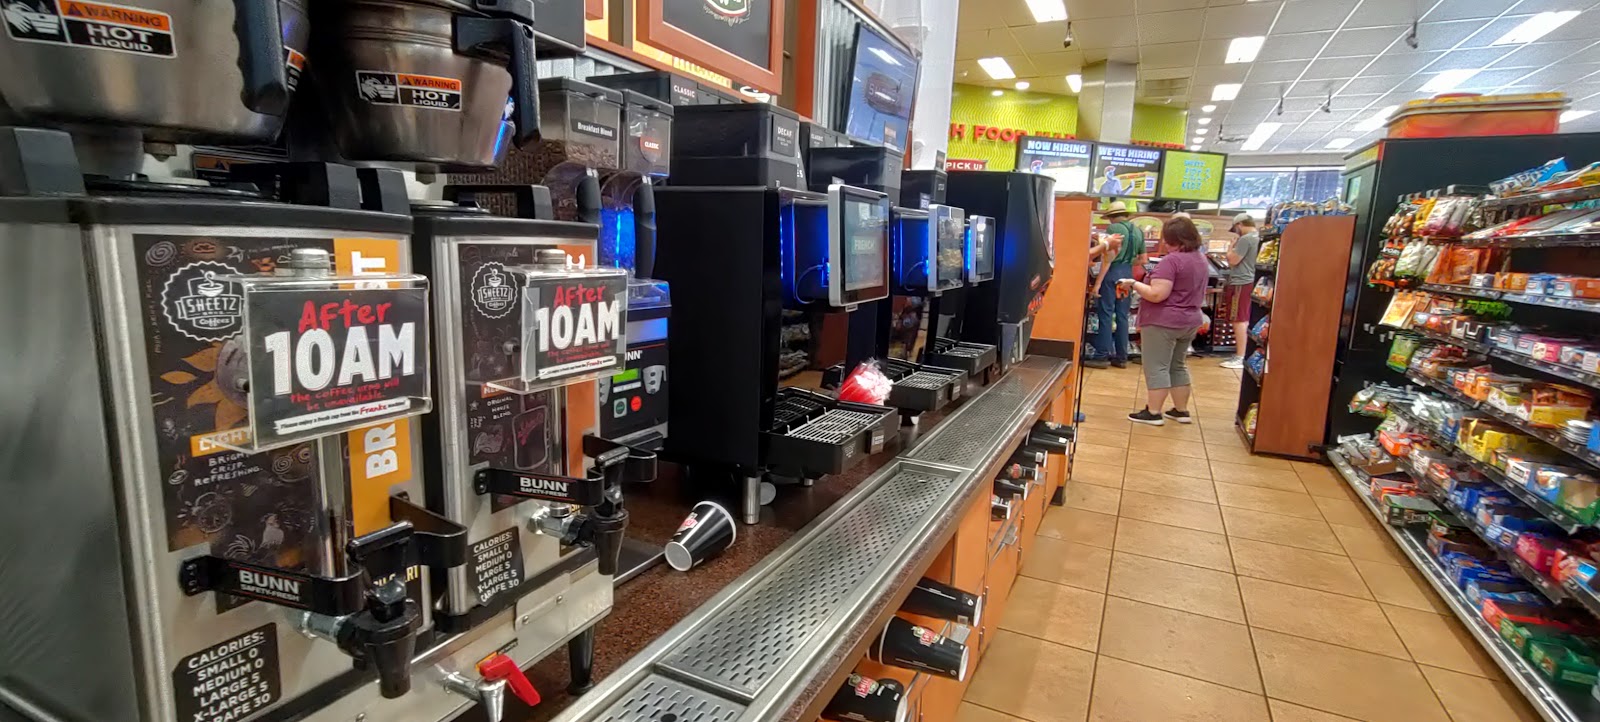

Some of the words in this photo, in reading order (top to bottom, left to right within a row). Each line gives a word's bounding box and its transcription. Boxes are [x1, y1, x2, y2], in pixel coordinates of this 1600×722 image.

[84, 4, 162, 27] WARNING
[86, 23, 153, 44] HOT
[90, 36, 153, 52] LIQUID
[413, 77, 457, 91] WARNING
[673, 85, 695, 98] CLASSIC
[411, 90, 449, 102] HOT
[413, 98, 449, 108] LIQUID
[577, 121, 600, 134] Breakfast
[600, 127, 613, 137] Blend
[777, 126, 792, 137] DECAF
[644, 141, 659, 150] CLASSIC
[1027, 140, 1052, 151] NOW
[1052, 142, 1087, 154] HIRING
[1098, 146, 1128, 157] WE'RE
[1128, 149, 1160, 160] HIRING
[946, 161, 971, 170] PICK
[482, 287, 508, 299] SHEETZ
[187, 297, 237, 313] SHEETZ
[534, 300, 620, 352] 10AM
[264, 322, 415, 397] 10AM
[357, 383, 381, 394] urns
[306, 402, 320, 411] be
[360, 403, 388, 416] Franke
[519, 476, 568, 492] BUNN
[520, 486, 568, 498] SAFETY-FRESH
[473, 531, 513, 553] CALORIES:
[477, 546, 503, 563] SMALL
[503, 543, 509, 551] 0
[475, 553, 505, 574] MEDIUM
[506, 551, 513, 559] 0
[478, 564, 504, 582] LARGE
[504, 561, 511, 569] 5
[238, 569, 299, 595] BUNN
[477, 571, 510, 594] X-LARGE
[510, 569, 517, 578] 5
[240, 583, 300, 601] SAFETY-FRESH
[480, 582, 507, 603] CARAFE
[508, 578, 520, 589] 30
[188, 631, 264, 669] CALORIES:
[197, 654, 246, 681] SMALL
[248, 647, 258, 659] 0
[193, 663, 252, 697] MEDIUM
[254, 658, 264, 669] 0
[200, 677, 249, 707] LARGE
[251, 671, 260, 684] 5
[193, 686, 257, 722] X-LARGE
[259, 681, 269, 692] 5
[253, 692, 271, 708] 30
